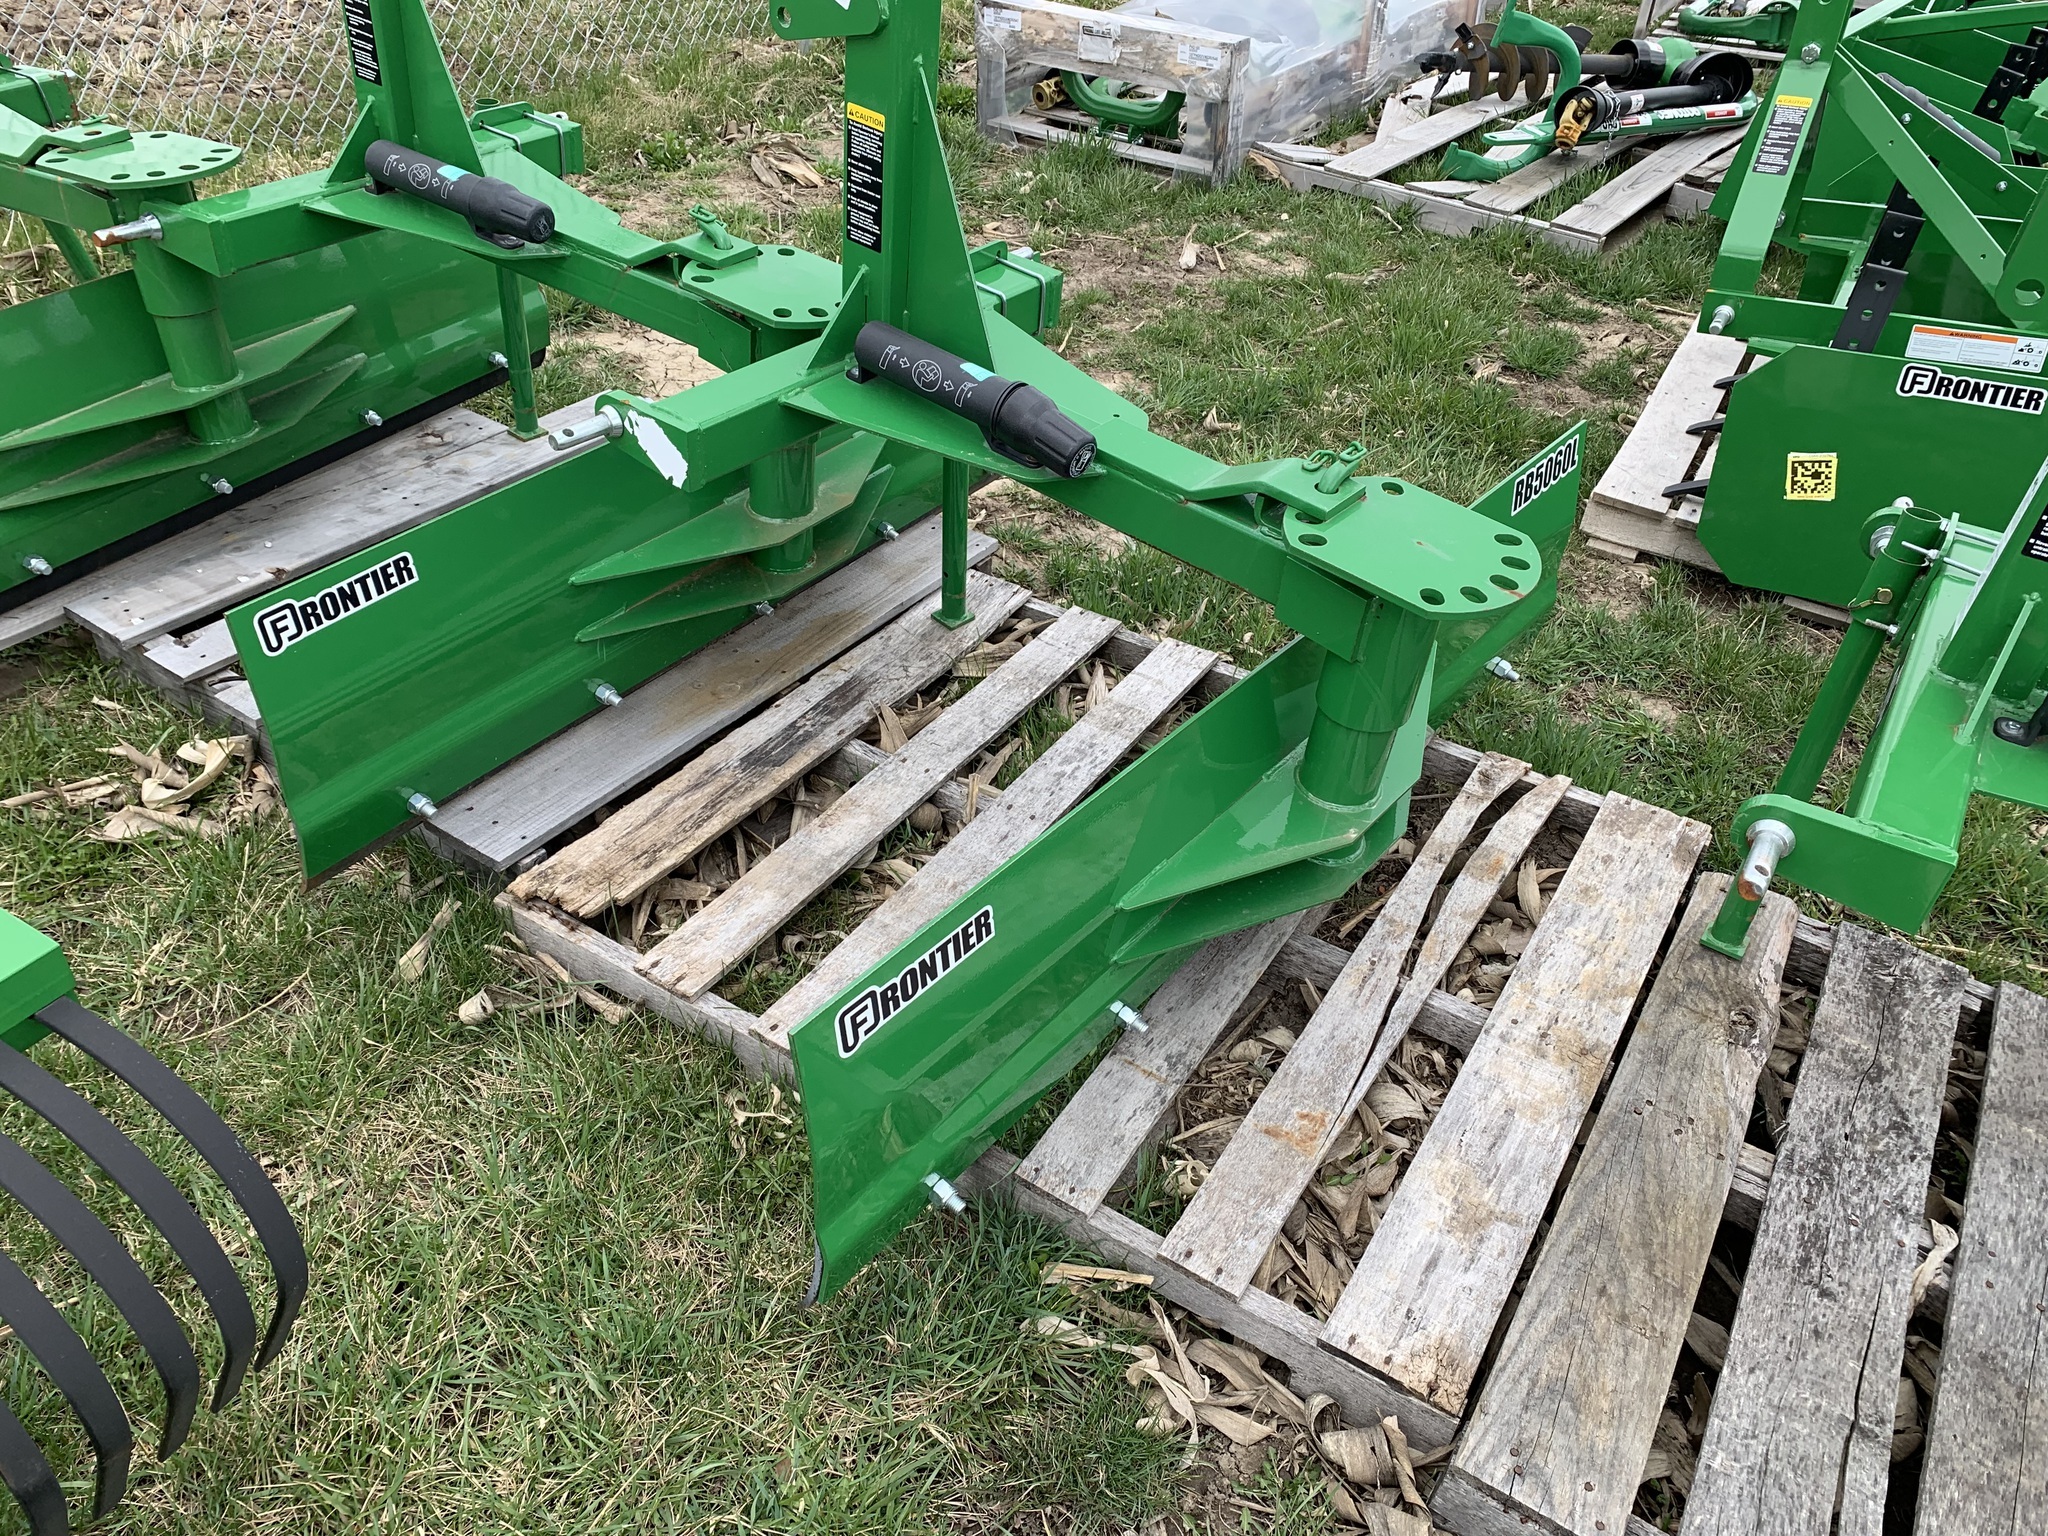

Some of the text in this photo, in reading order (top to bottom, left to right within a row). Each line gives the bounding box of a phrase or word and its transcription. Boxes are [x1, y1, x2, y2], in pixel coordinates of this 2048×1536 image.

[855, 111, 884, 127] CAUTION
[1953, 332, 1982, 340] WARNING
[1899, 365, 2045, 412] FRONTIER
[1512, 437, 1578, 513] RB5060L
[257, 554, 415, 653] FRONTIER
[838, 908, 993, 1054] FRONTIER
